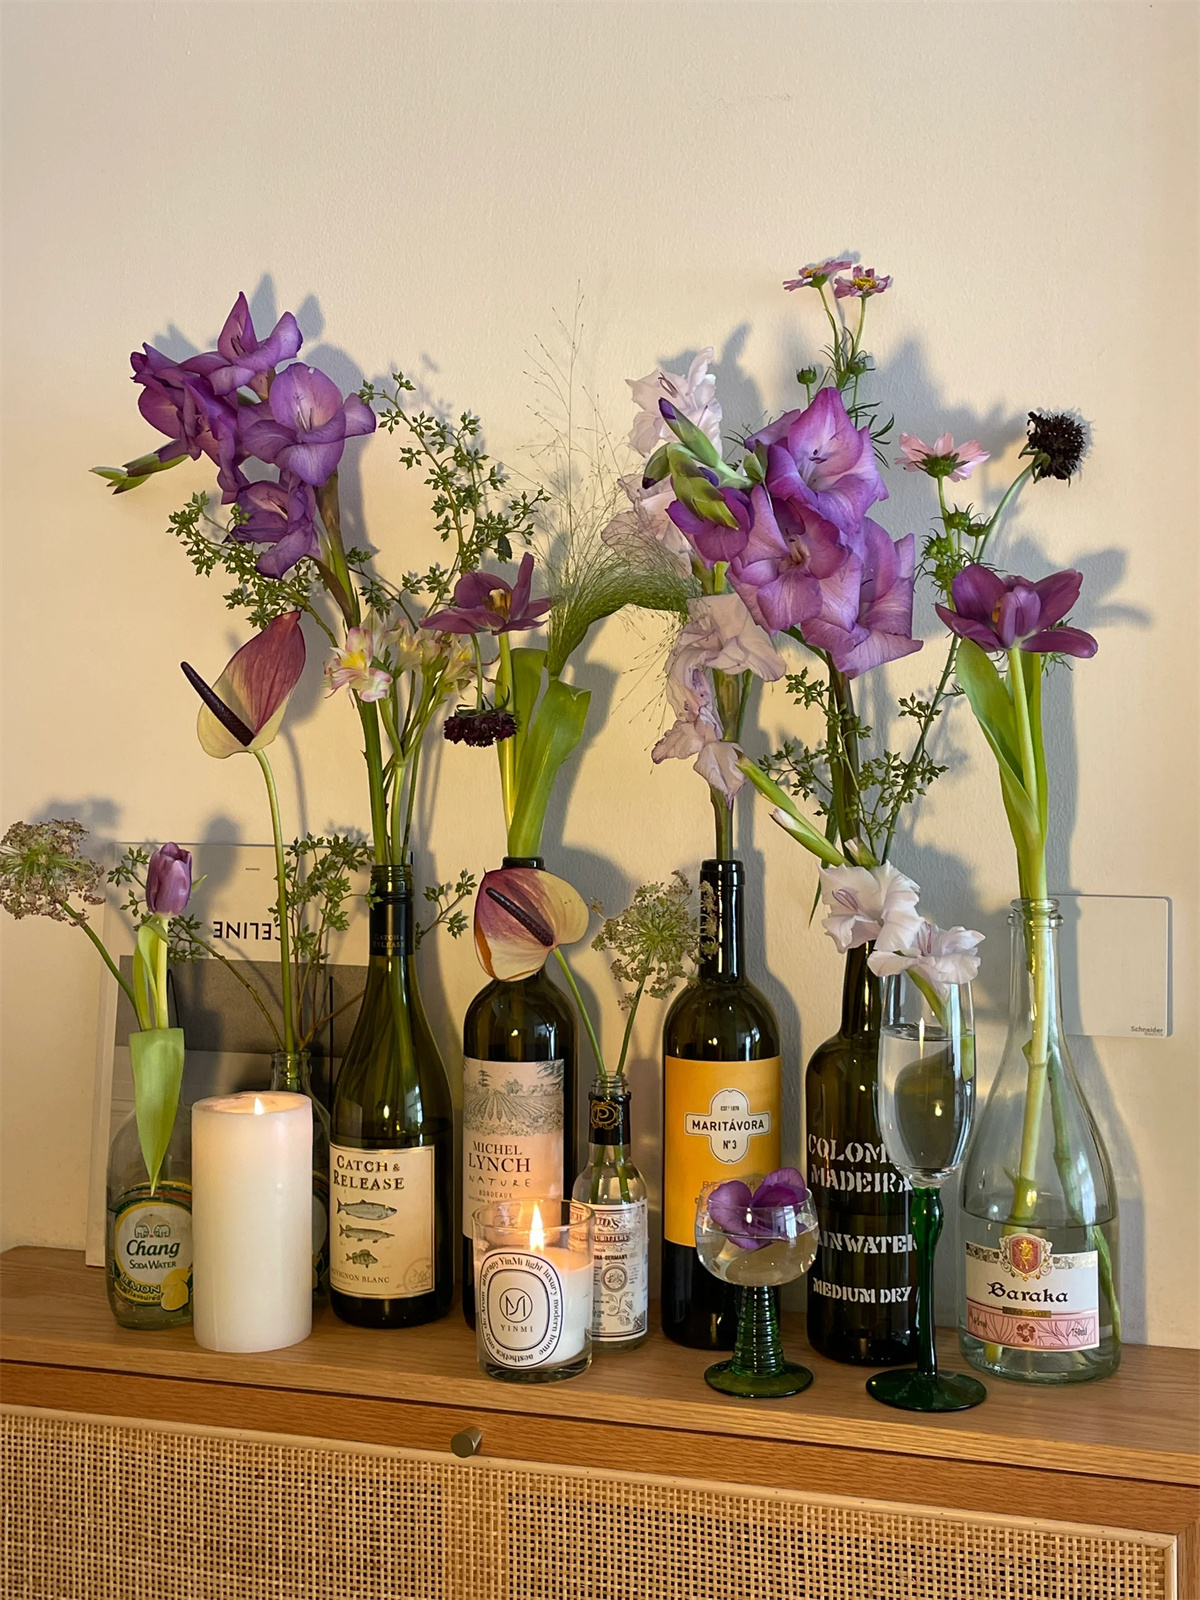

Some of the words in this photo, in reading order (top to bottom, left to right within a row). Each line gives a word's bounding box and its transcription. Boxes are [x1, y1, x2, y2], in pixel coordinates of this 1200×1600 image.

[692, 1118, 765, 1132] MARITÁVORA
[473, 1140, 523, 1156] MICHEL
[732, 1139, 738, 1150] 3
[808, 1133, 894, 1164] COLOM
[336, 1154, 388, 1173] CATCH
[392, 1163, 400, 1172] &
[468, 1152, 531, 1173] LYNCH
[333, 1169, 405, 1191] RELEASE
[468, 1175, 531, 1188] NATURE
[478, 1189, 513, 1199] BORDEAUX
[126, 1239, 181, 1259] Chang
[525, 1257, 544, 1272] light
[119, 1271, 162, 1295] LEMON
[361, 1274, 390, 1284] BLANC
[543, 1268, 559, 1296] luxury
[812, 1276, 876, 1304] MEDIUM
[880, 1286, 913, 1304] DRY
[986, 1281, 1069, 1303] Baraka
[552, 1298, 561, 1332] modern
[500, 1323, 534, 1333] YINMI
[539, 1333, 558, 1356] home
[496, 1349, 534, 1363] aesthetics
